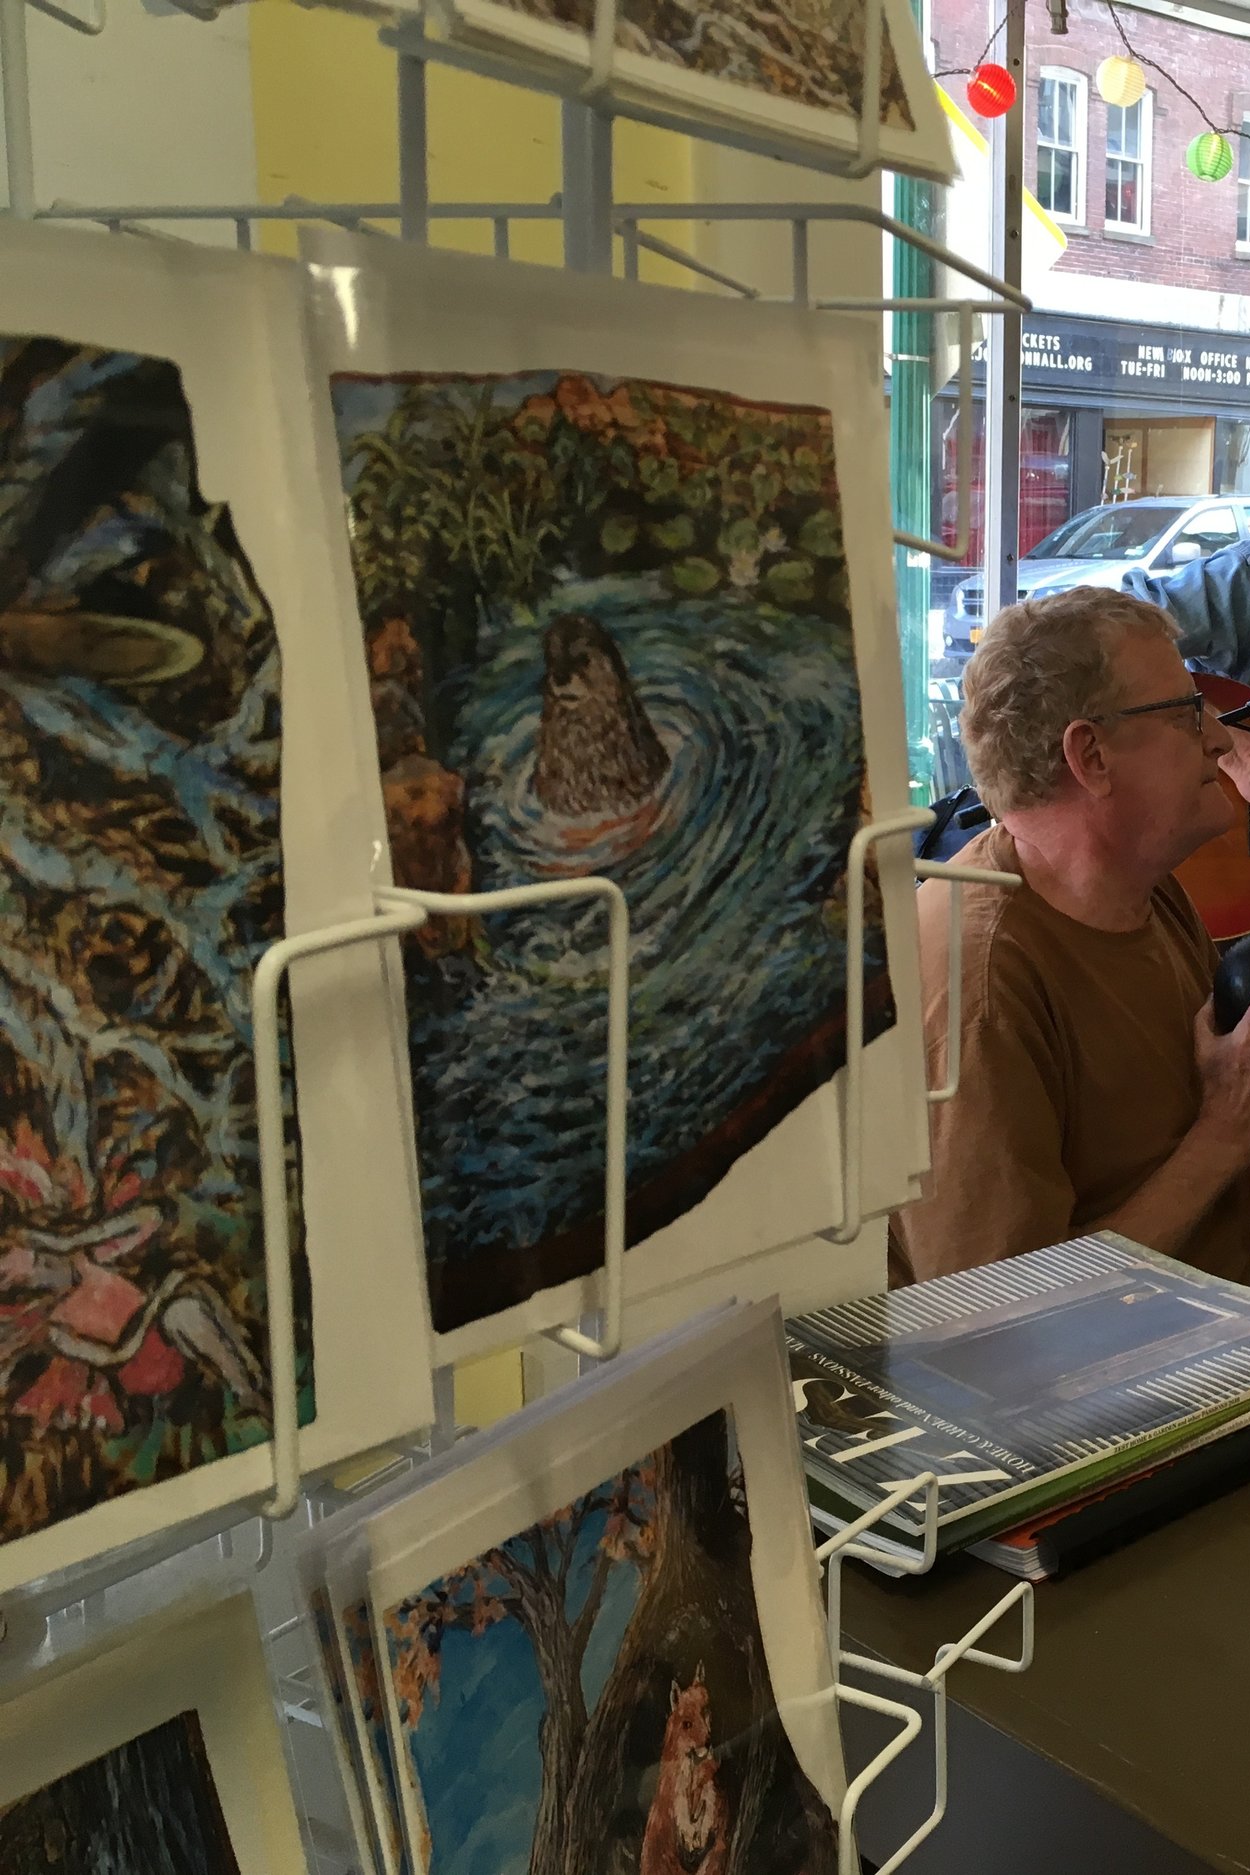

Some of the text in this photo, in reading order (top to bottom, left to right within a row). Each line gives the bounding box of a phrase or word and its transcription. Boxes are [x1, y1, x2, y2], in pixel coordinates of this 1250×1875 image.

[1021, 333, 1061, 351] CKETS
[1138, 345, 1164, 362] NEW
[1200, 351, 1238, 368] OFFICE
[1120, 360, 1165, 378] TUE-FRI
[1182, 366, 1241, 385] NOON-3:00
[808, 1353, 872, 1388] PASSIONS
[869, 1384, 901, 1405] other
[897, 1400, 925, 1417] and
[922, 1409, 980, 1445] GARDEN
[1153, 1423, 1177, 1437] GARDEN
[992, 1444, 1036, 1474] HOME
